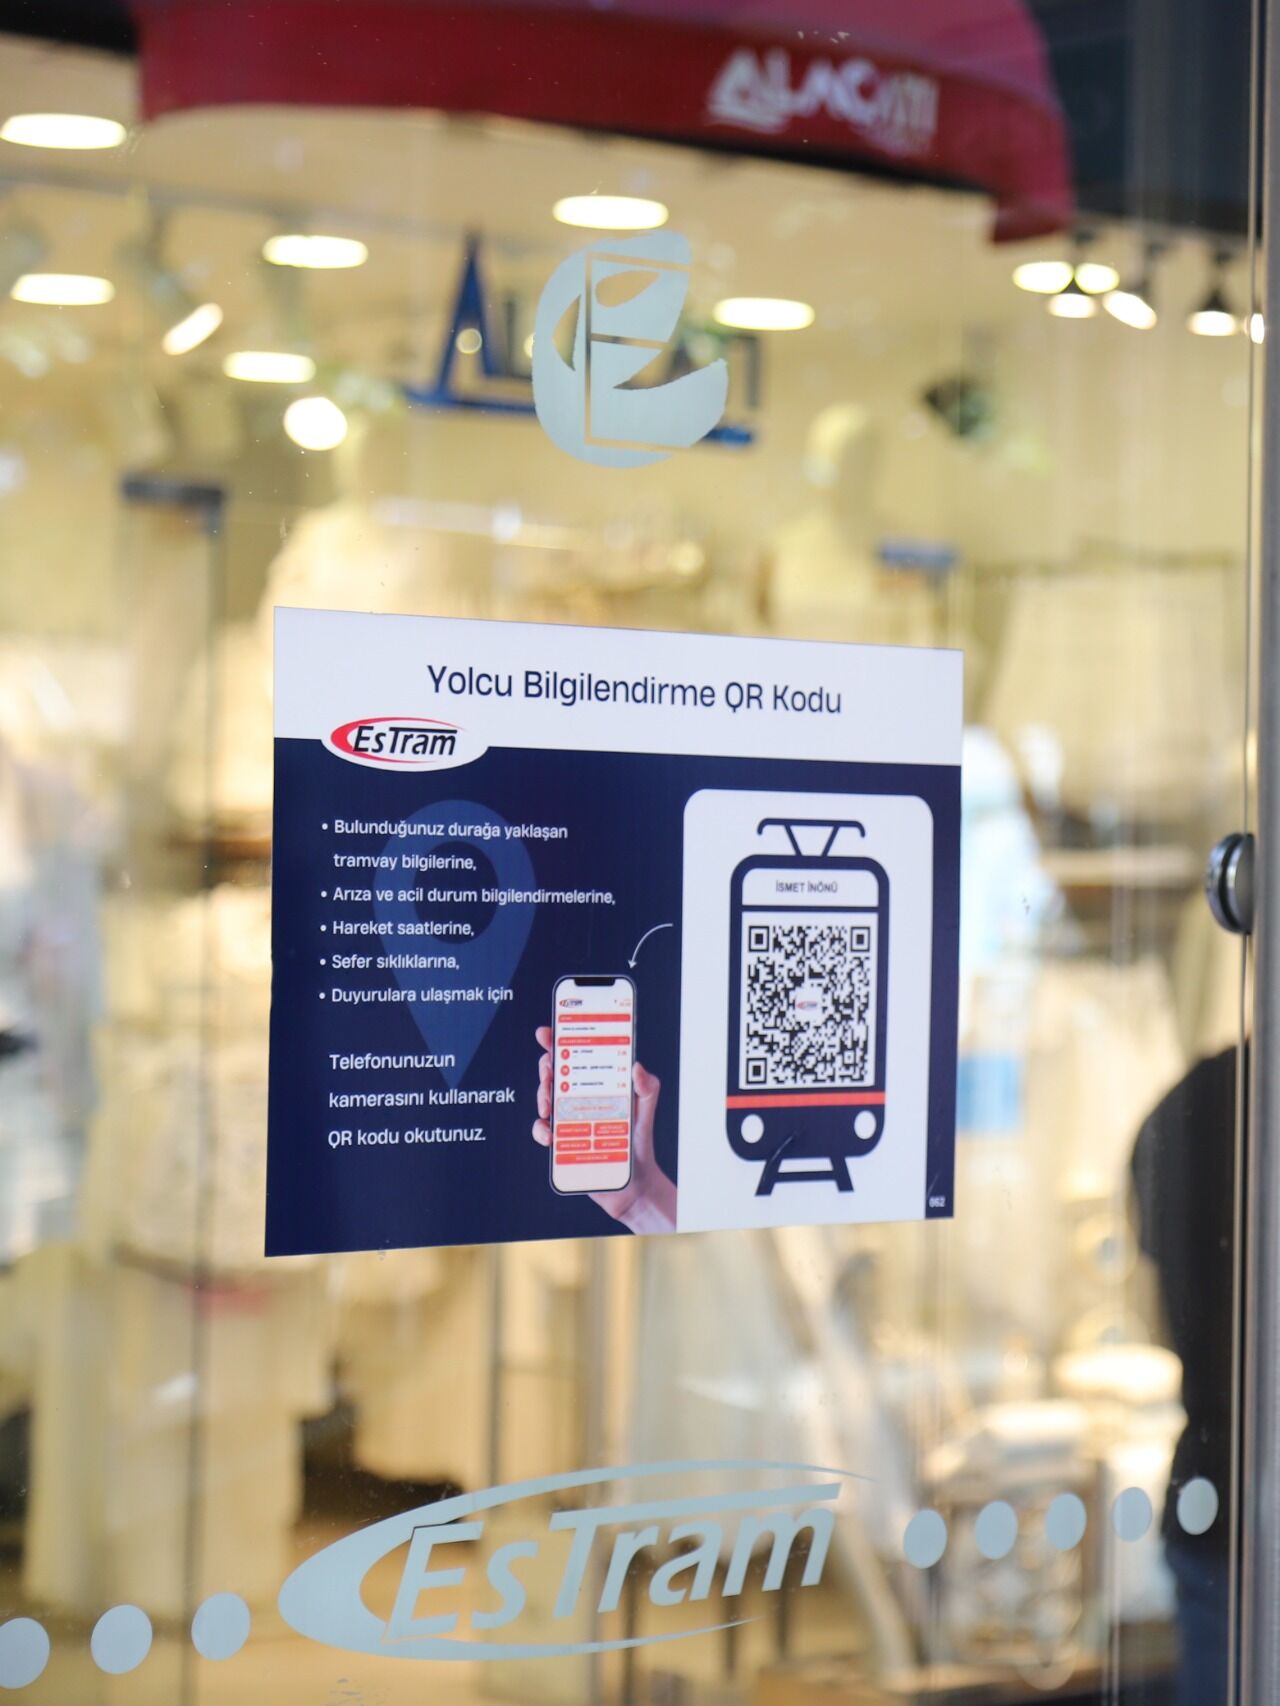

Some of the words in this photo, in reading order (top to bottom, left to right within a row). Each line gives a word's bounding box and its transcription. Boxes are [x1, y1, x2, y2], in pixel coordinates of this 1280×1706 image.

[427, 665, 513, 697] Yolcu
[523, 670, 716, 707] Bilgilendirme
[724, 681, 763, 712] QR
[773, 685, 842, 713] Kodu
[352, 725, 458, 757] EsTram
[334, 819, 445, 838] Bulunduğunuz
[448, 822, 501, 839] durağa
[504, 823, 568, 841] yaklaşan
[333, 853, 398, 870] tramvay
[402, 854, 477, 872] bilgilerine,
[333, 886, 372, 902] Arıza
[376, 890, 394, 902] ve
[397, 887, 423, 902] acil
[427, 887, 478, 903] durum
[481, 888, 616, 906] bilgilendirmelerine,
[775, 880, 805, 893] İSMET
[807, 880, 839, 893] İNÖNÜ
[332, 920, 394, 936] Hareket
[397, 921, 475, 937] saatlerine,
[331, 954, 373, 969] Sefer
[376, 954, 460, 971] sıklıklarına,
[331, 987, 417, 1004] Duyurulara
[420, 986, 484, 1003] ulaşmak
[488, 985, 514, 1002] için
[329, 1052, 456, 1071] Telefonunuzun
[329, 1092, 424, 1108] kamerasını
[428, 1087, 516, 1105] kullanarak
[327, 1130, 352, 1149] QR
[357, 1128, 400, 1146] kodu
[404, 1127, 486, 1144] okutunuz.
[380, 1482, 841, 1641] EsTram
